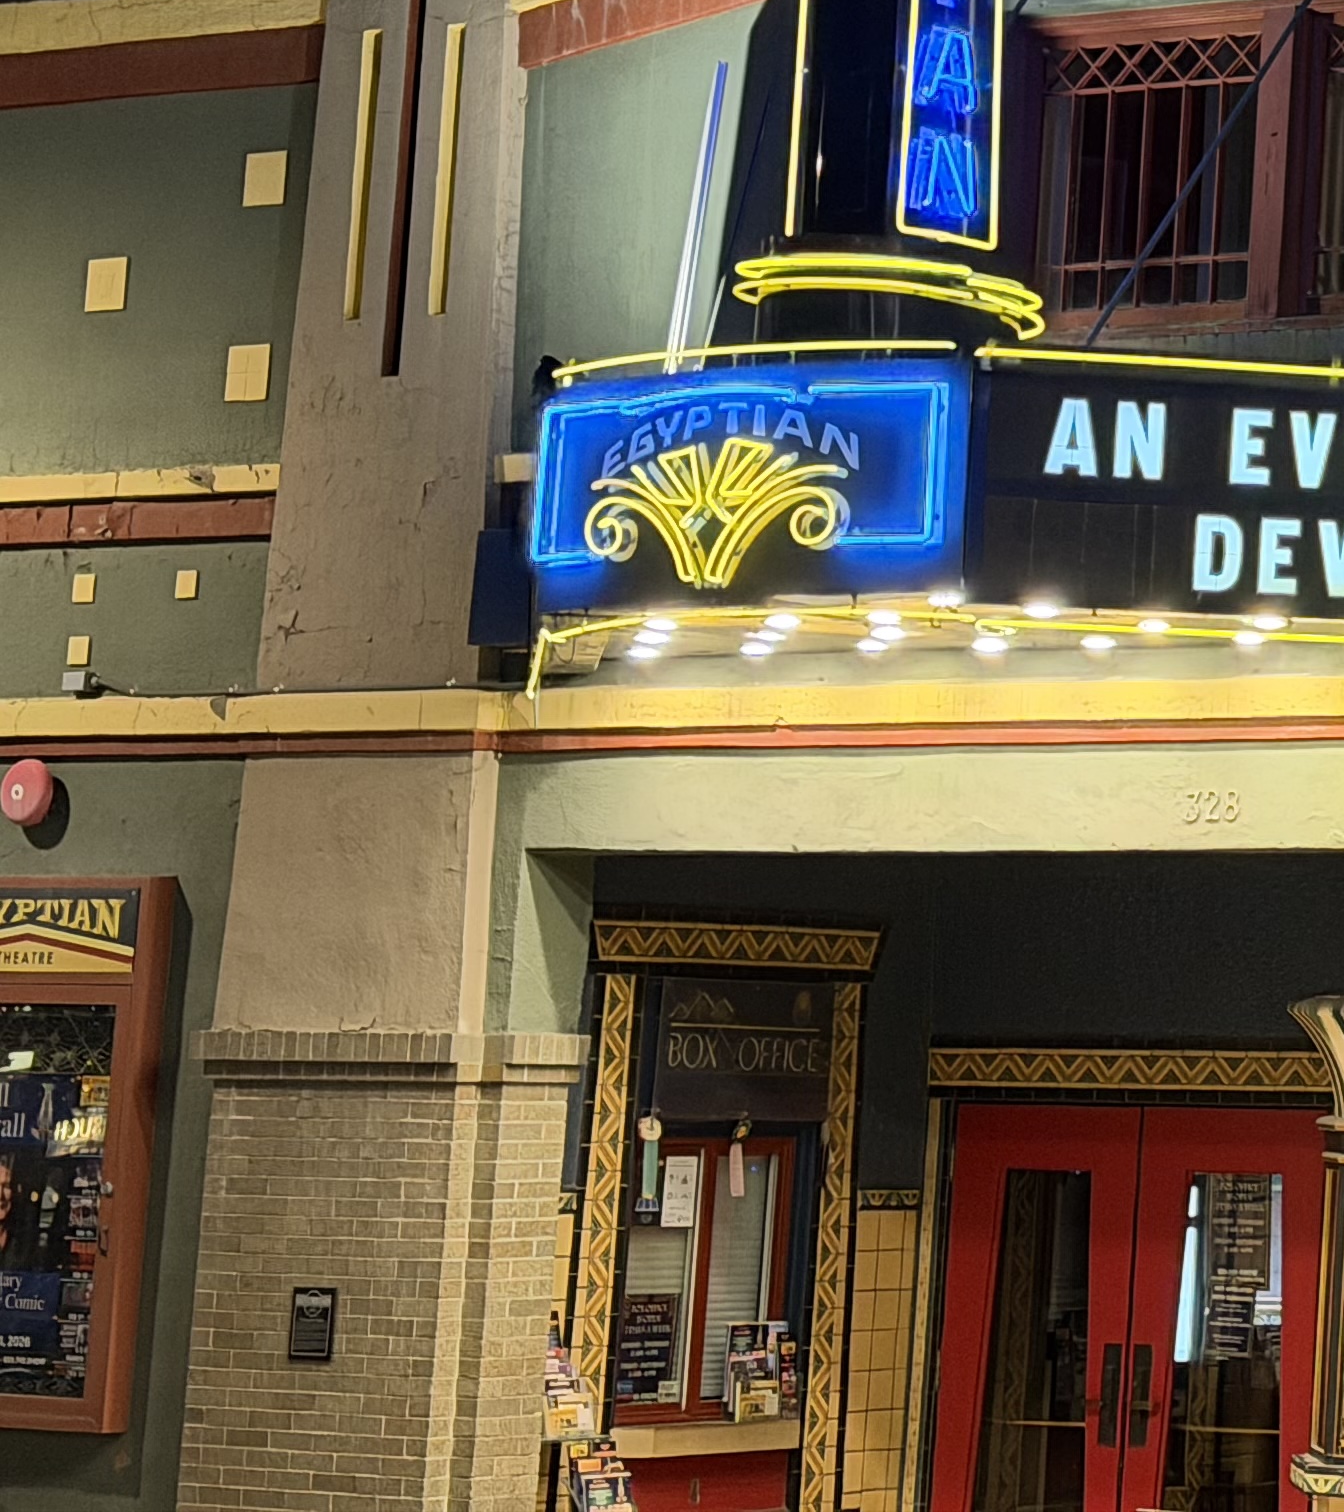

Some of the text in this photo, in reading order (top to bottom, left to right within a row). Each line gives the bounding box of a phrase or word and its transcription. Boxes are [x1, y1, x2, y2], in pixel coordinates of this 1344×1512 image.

[602, 402, 861, 479] EGYPTIAN
[1044, 397, 1167, 481] AN
[1182, 790, 1241, 824] 328
[668, 1032, 821, 1073] BOX OFFICE
[4, 1292, 46, 1311] Comic
